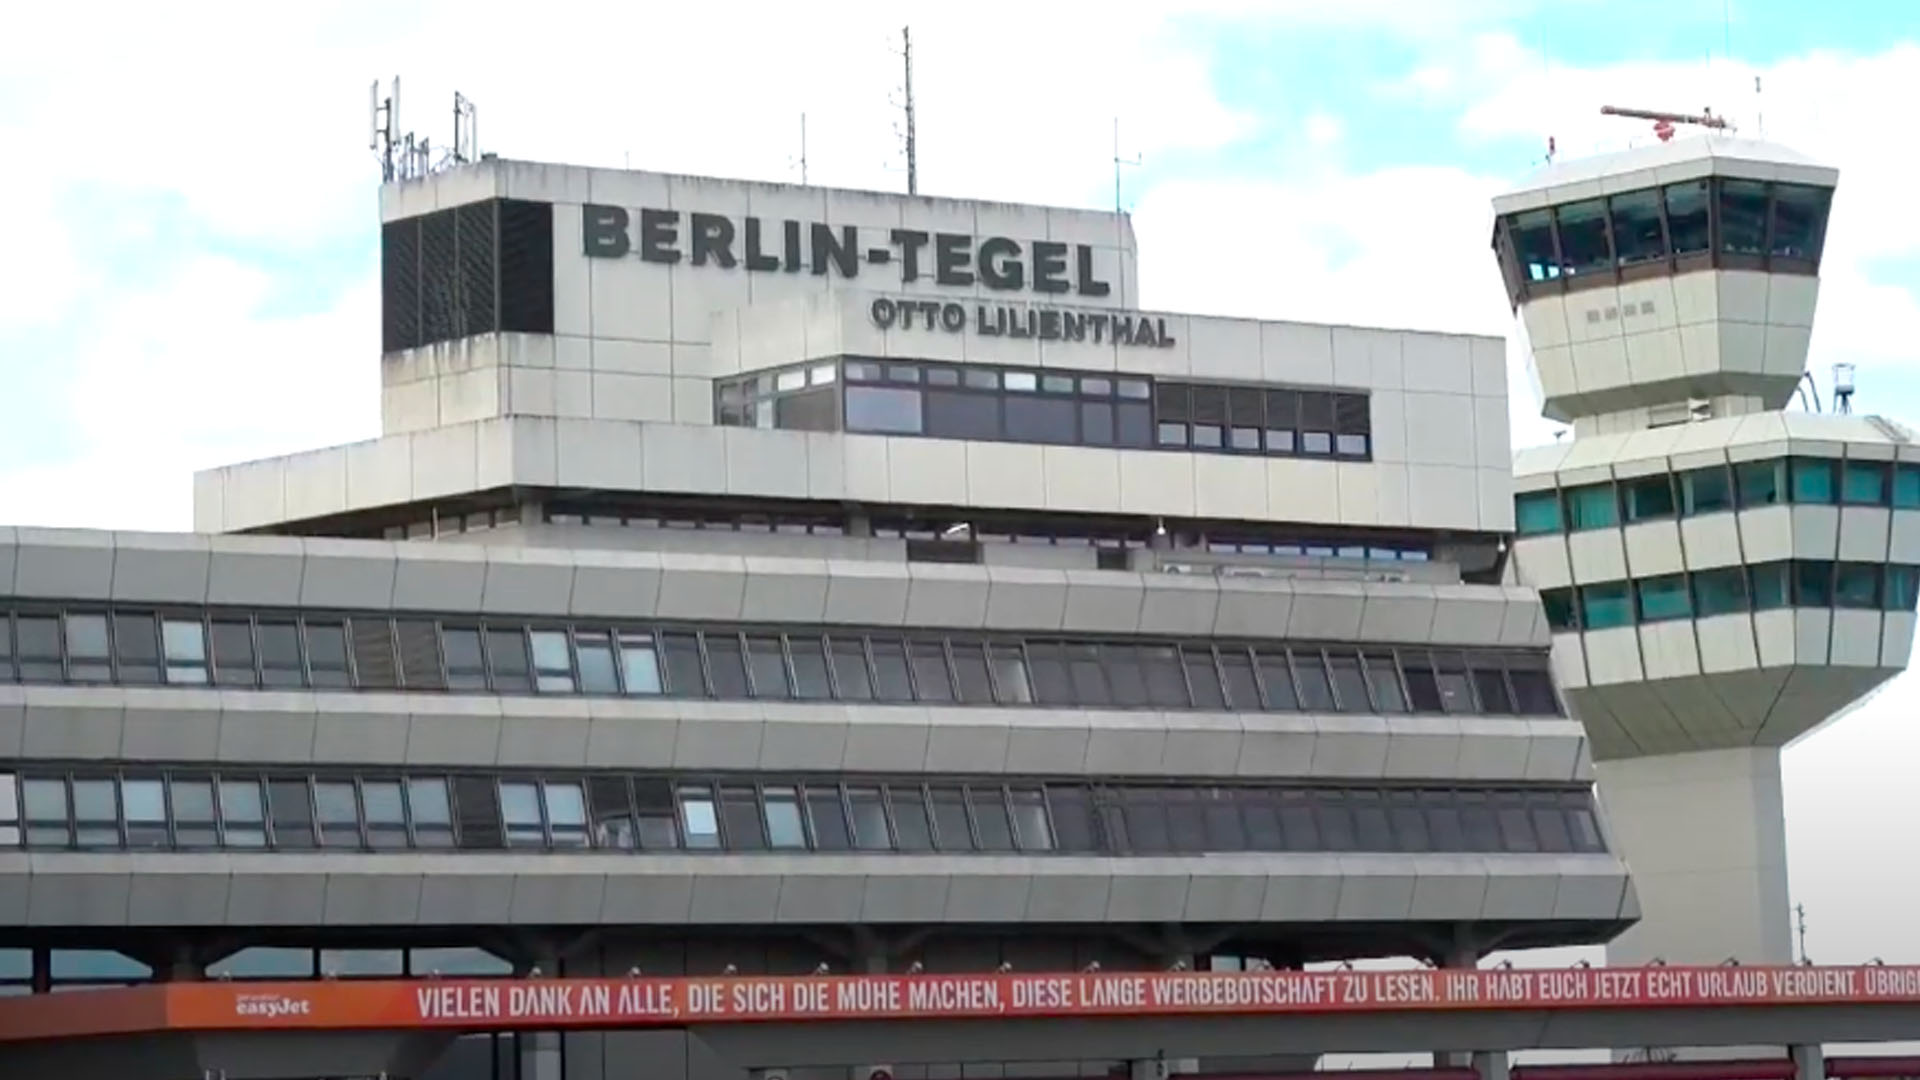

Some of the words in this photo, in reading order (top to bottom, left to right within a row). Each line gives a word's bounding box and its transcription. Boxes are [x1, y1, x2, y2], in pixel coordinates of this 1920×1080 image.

[582, 203, 1110, 297] BERLIN-TEGEL
[871, 298, 966, 332] OTTO
[977, 304, 1176, 348] LILIENTHAL
[236, 998, 311, 1017] easyJet
[417, 987, 499, 1018] VIELEN
[509, 986, 572, 1016] DANK
[579, 986, 610, 1016] AN
[618, 984, 680, 1017] ALLE,
[688, 983, 725, 1013] DIE
[733, 982, 785, 1012] SICH
[793, 981, 830, 1011] DIE
[838, 978, 901, 1011] MÜHE
[908, 979, 1005, 1013] MACHEN,
[1012, 978, 1072, 1008] DIESE
[1079, 977, 1147, 1007] LANGE
[1152, 974, 1338, 1005] WERBEBOTSCHAFT
[1343, 974, 1369, 1003] ZU
[1375, 973, 1441, 1002] LESEN.
[1447, 973, 1480, 1001] IHR
[1486, 972, 1534, 1000] HABT
[1539, 972, 1588, 999] EUCH
[1594, 971, 1641, 999] JETZT
[1647, 970, 1692, 998] ECHT
[1699, 970, 1768, 998] URLAUB
[1773, 969, 1860, 996] VERDIENT.
